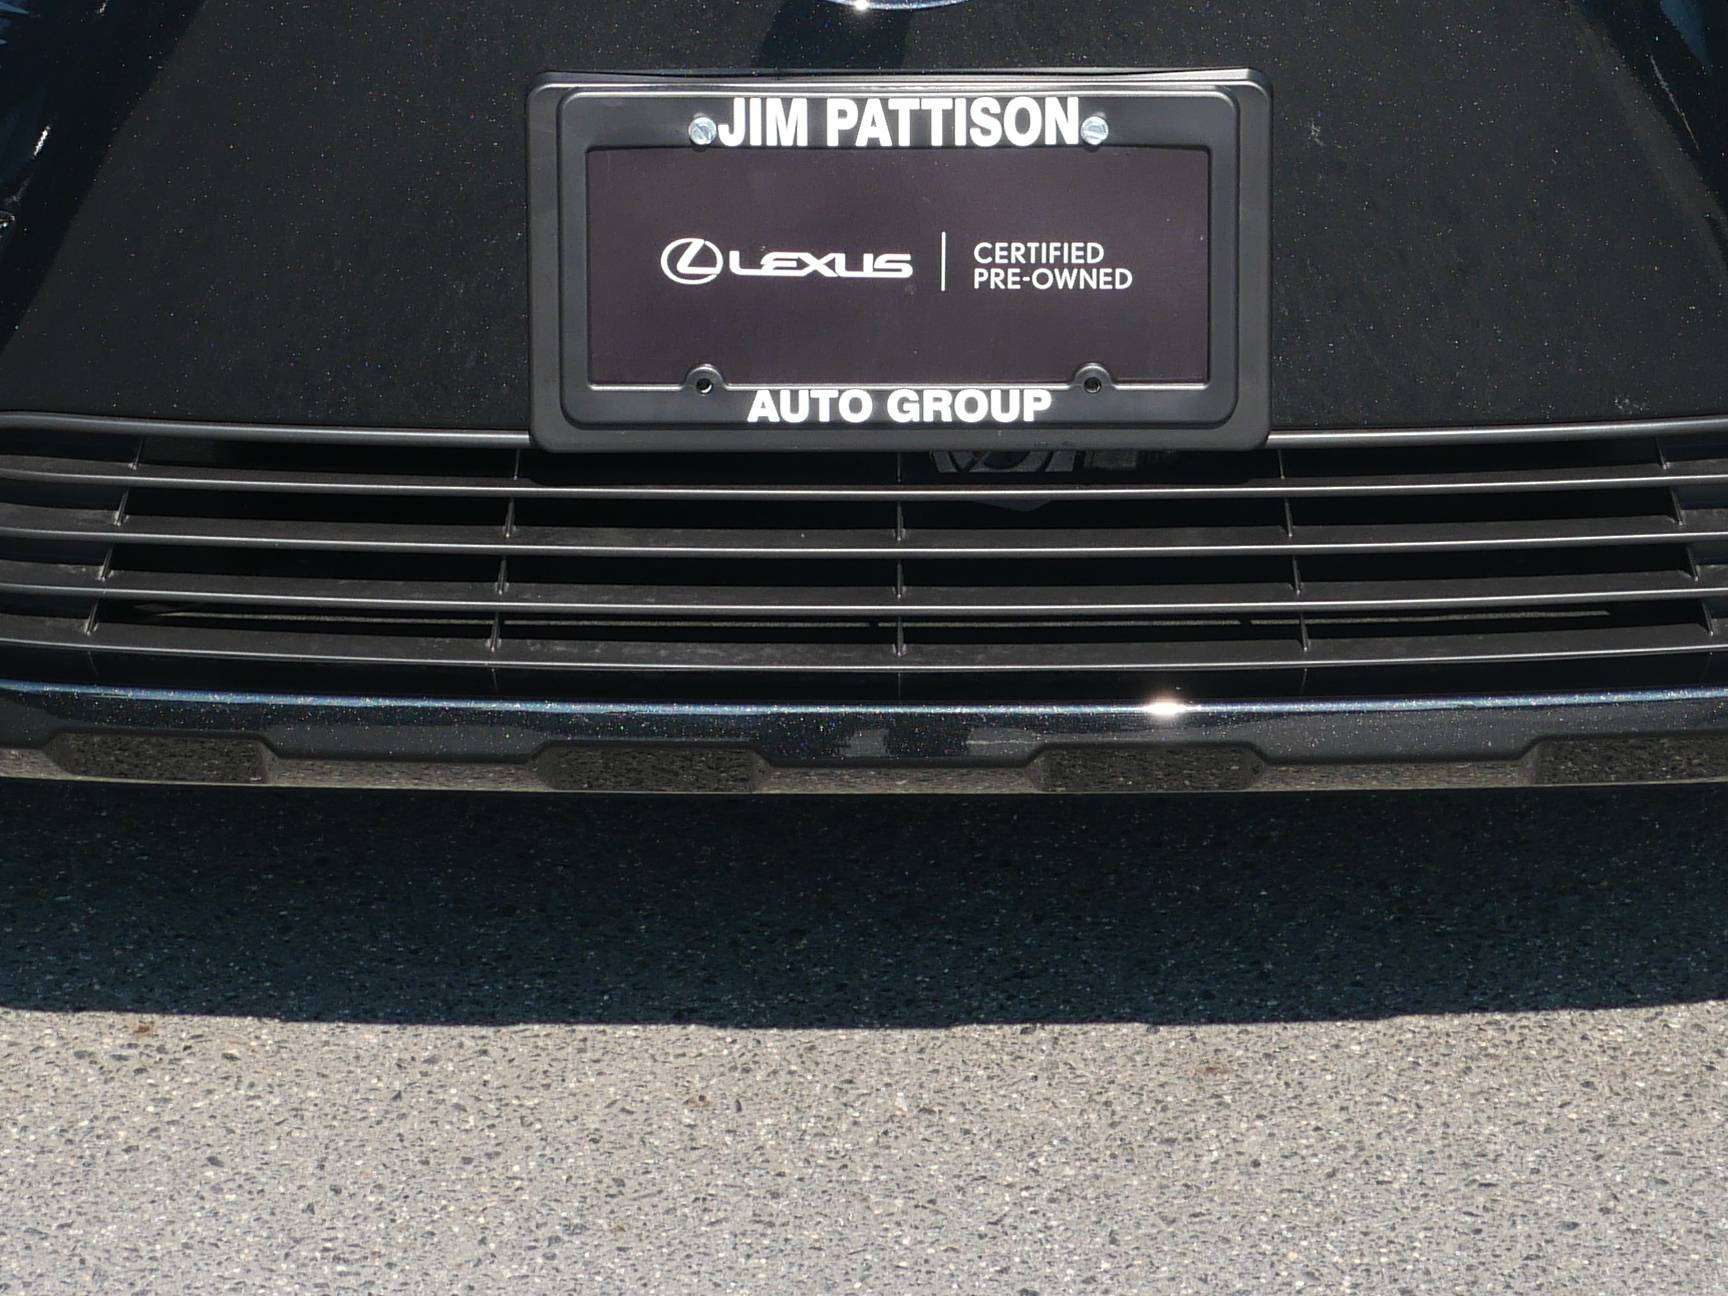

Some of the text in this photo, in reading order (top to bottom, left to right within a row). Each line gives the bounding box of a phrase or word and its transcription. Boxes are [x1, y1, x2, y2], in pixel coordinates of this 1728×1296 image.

[717, 96, 1080, 147] JIM PATTISON
[729, 249, 914, 279] LEXUS
[973, 241, 1105, 265] CERTIFIED
[973, 267, 1134, 291] PRE-OWNED
[746, 388, 1053, 423] AUTO GROUP
